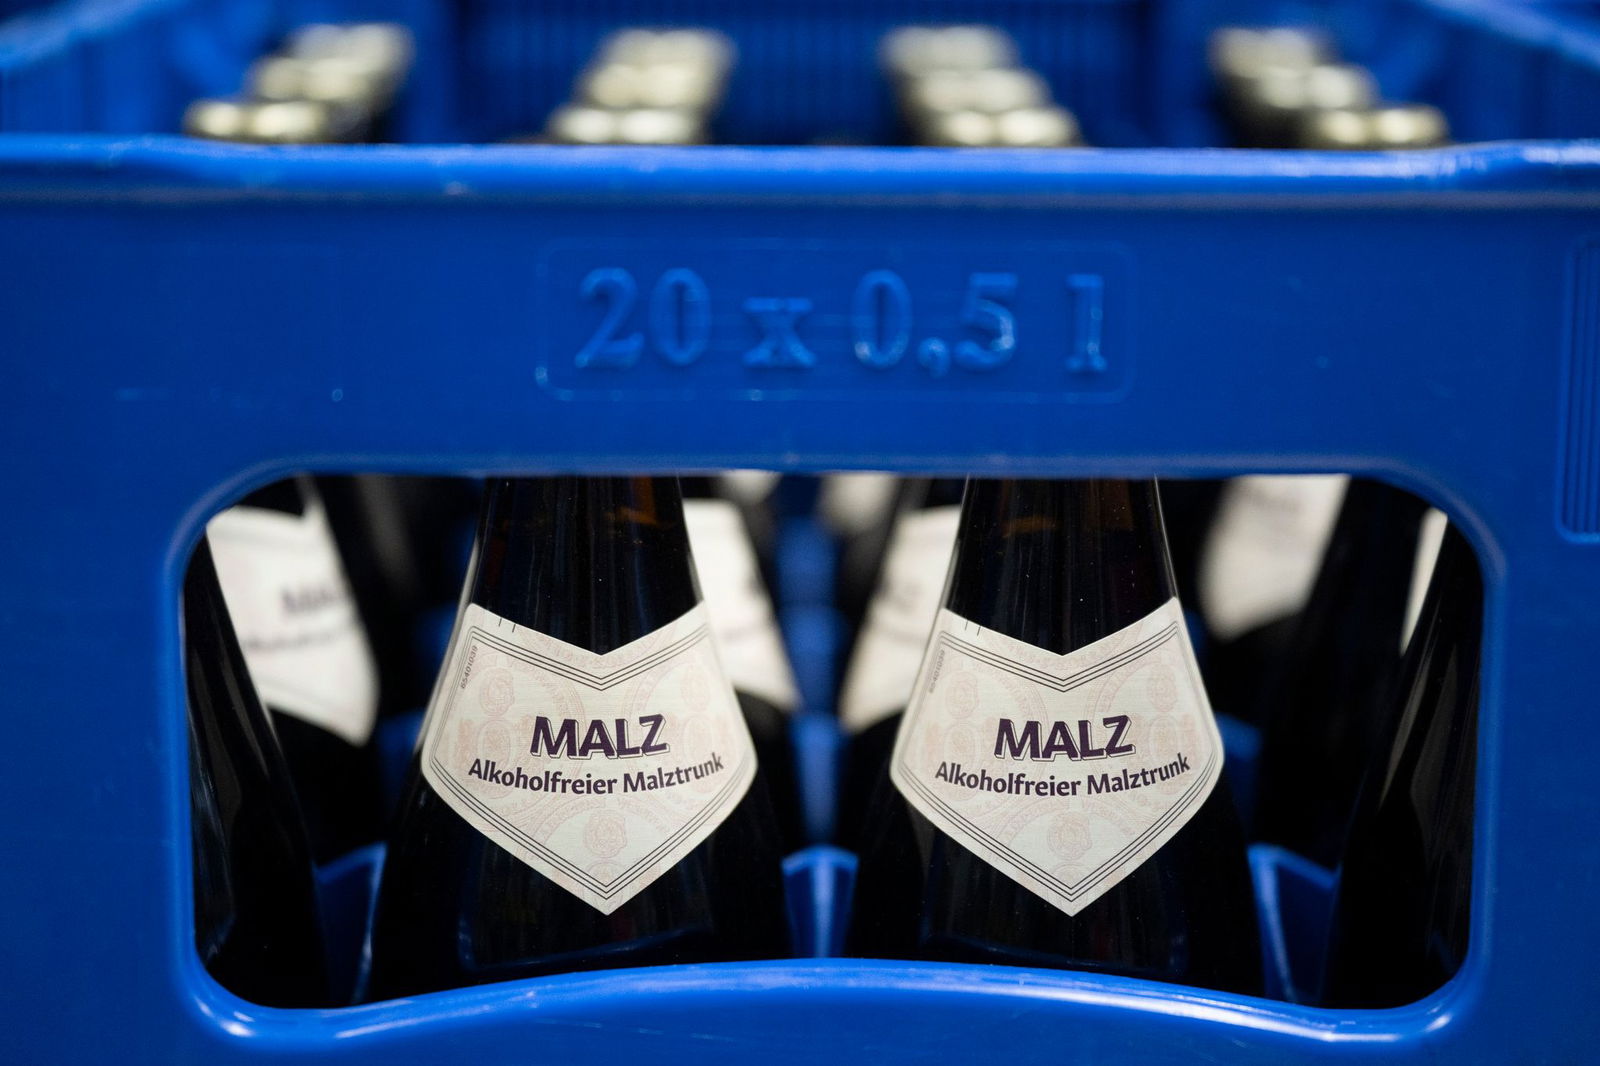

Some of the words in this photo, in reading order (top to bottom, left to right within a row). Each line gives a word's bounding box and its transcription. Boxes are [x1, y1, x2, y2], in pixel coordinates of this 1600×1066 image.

[574, 267, 711, 370] 20
[742, 297, 816, 368] x
[851, 269, 1018, 376] 0,5
[530, 713, 670, 760] MALZ
[993, 714, 1136, 762] MALZ
[468, 758, 618, 795] Alkoholfreier
[623, 752, 725, 793] Malztrunk
[934, 761, 1082, 796] Alkoholfreier
[1086, 752, 1191, 795] Malztrunk
